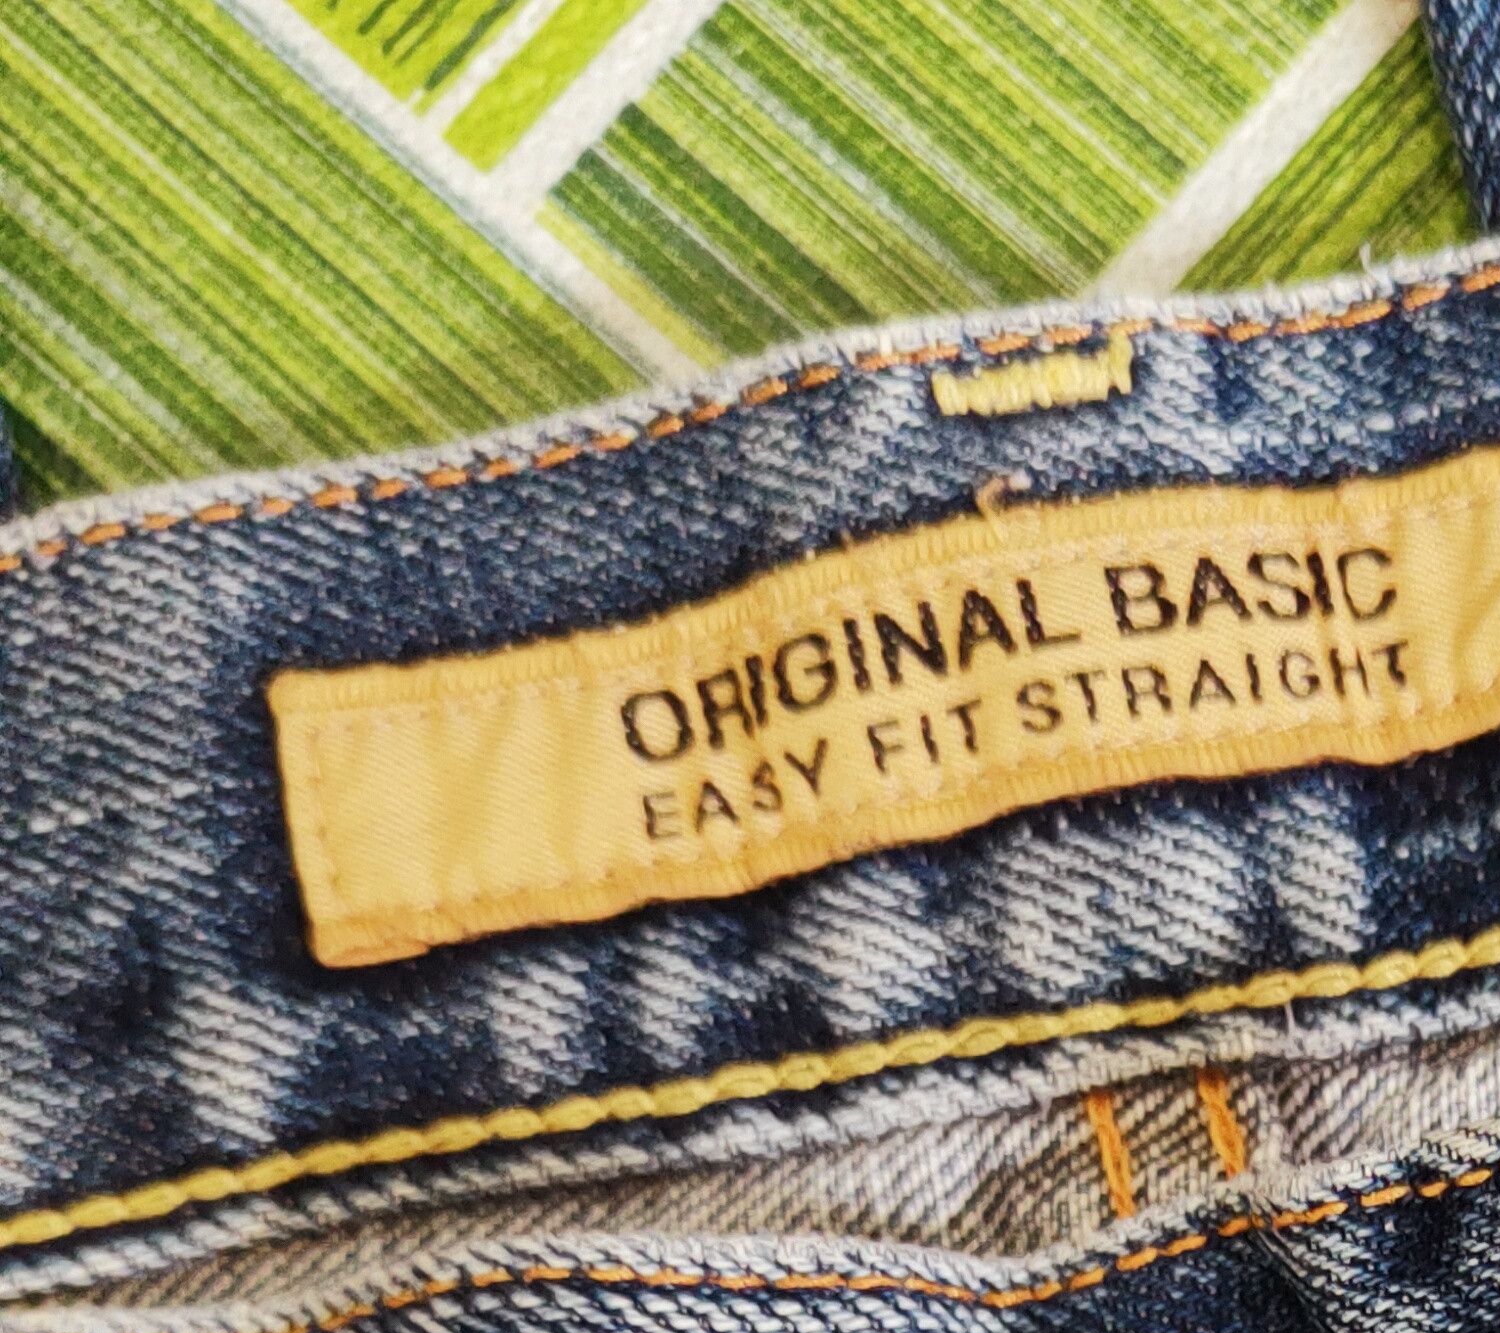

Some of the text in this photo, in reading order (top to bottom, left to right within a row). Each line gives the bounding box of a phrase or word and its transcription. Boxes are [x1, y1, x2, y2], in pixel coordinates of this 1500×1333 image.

[620, 548, 1398, 763] ORIGINAL BASIC
[641, 640, 1409, 841] EASY FIT STRAIGHT
